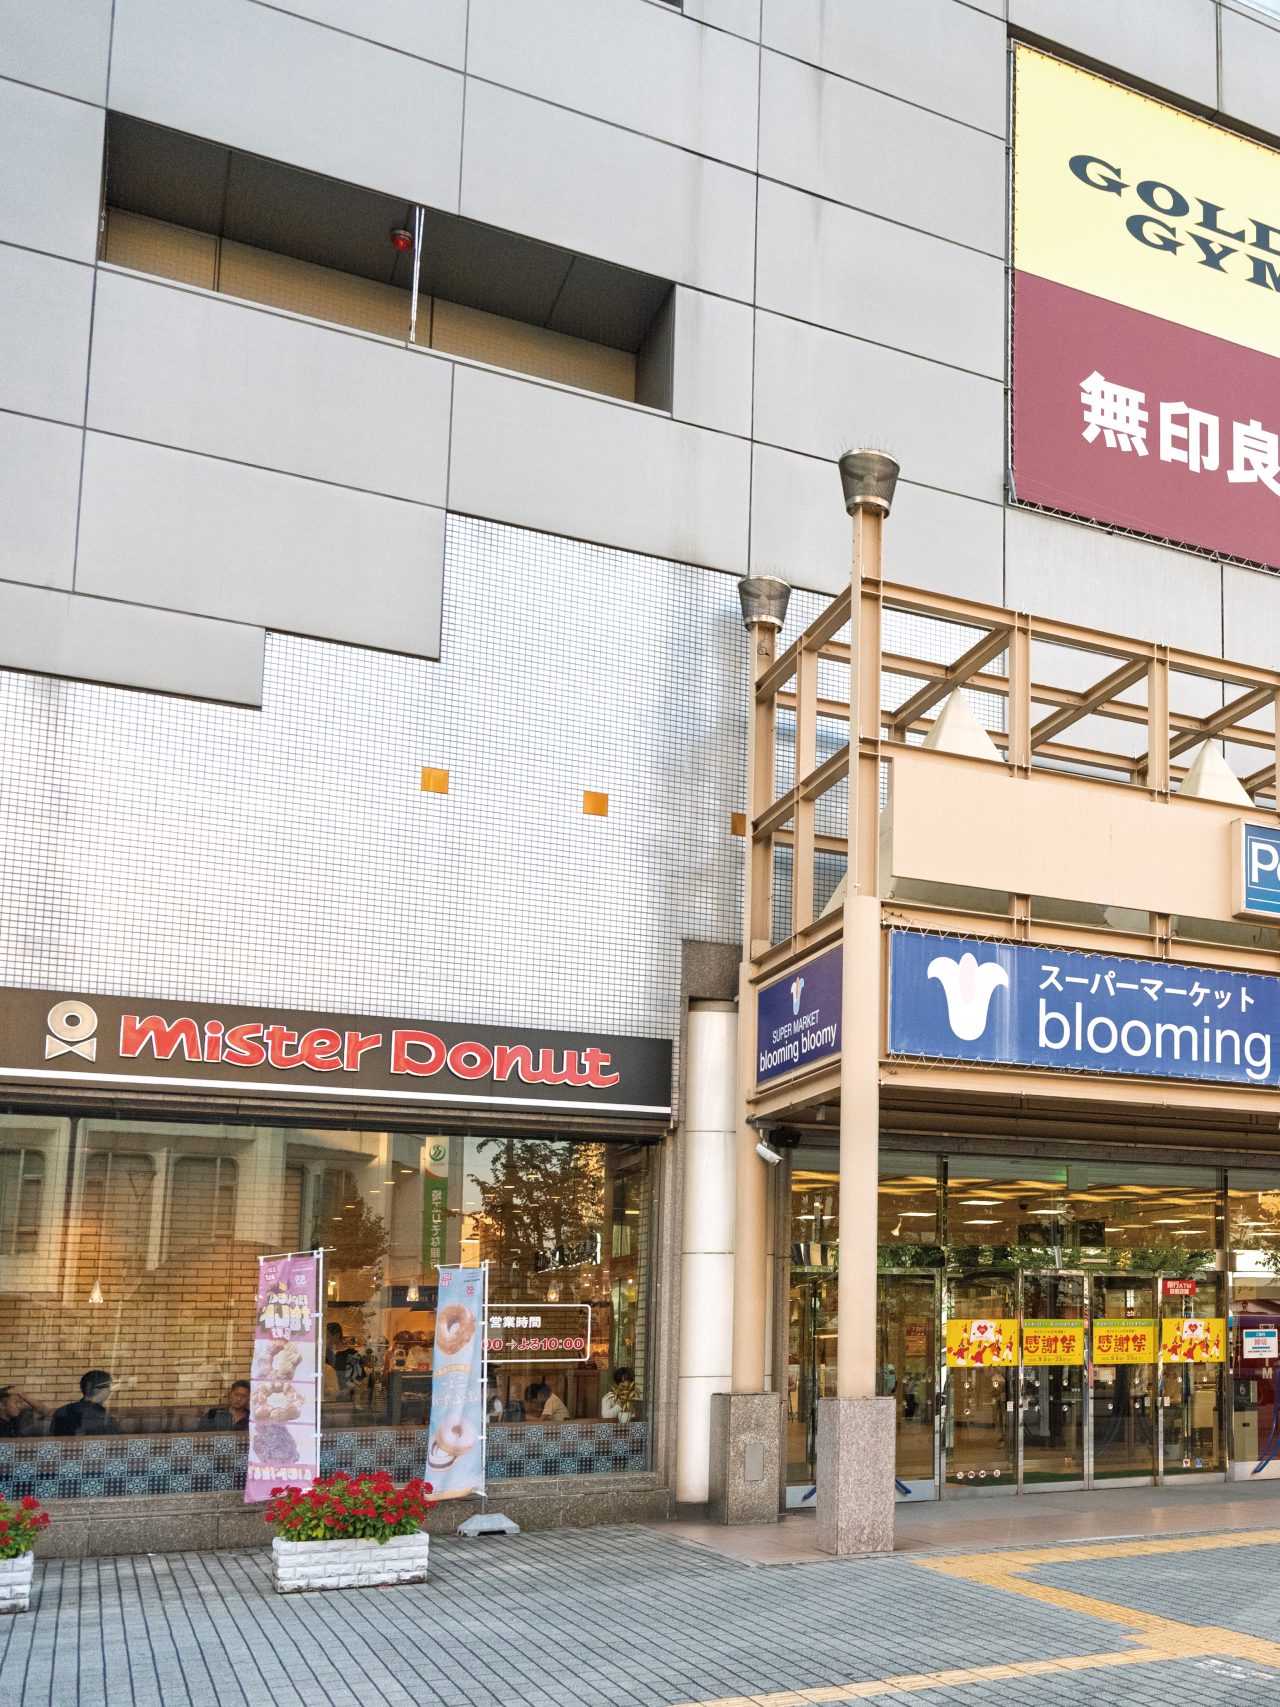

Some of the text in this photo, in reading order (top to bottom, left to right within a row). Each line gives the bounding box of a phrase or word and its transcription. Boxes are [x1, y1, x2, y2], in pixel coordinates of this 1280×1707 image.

[1039, 965, 1255, 1013] スーパーマーケット
[772, 1009, 820, 1044] SUPER MARKET
[1038, 998, 1272, 1080] blooming
[119, 1014, 620, 1089] Mister Donut
[759, 1023, 837, 1072] blooming bloomy
[489, 1316, 542, 1329] 営業時間
[1024, 1334, 1077, 1355] 感謝祭
[1097, 1334, 1147, 1353] 感謝祭
